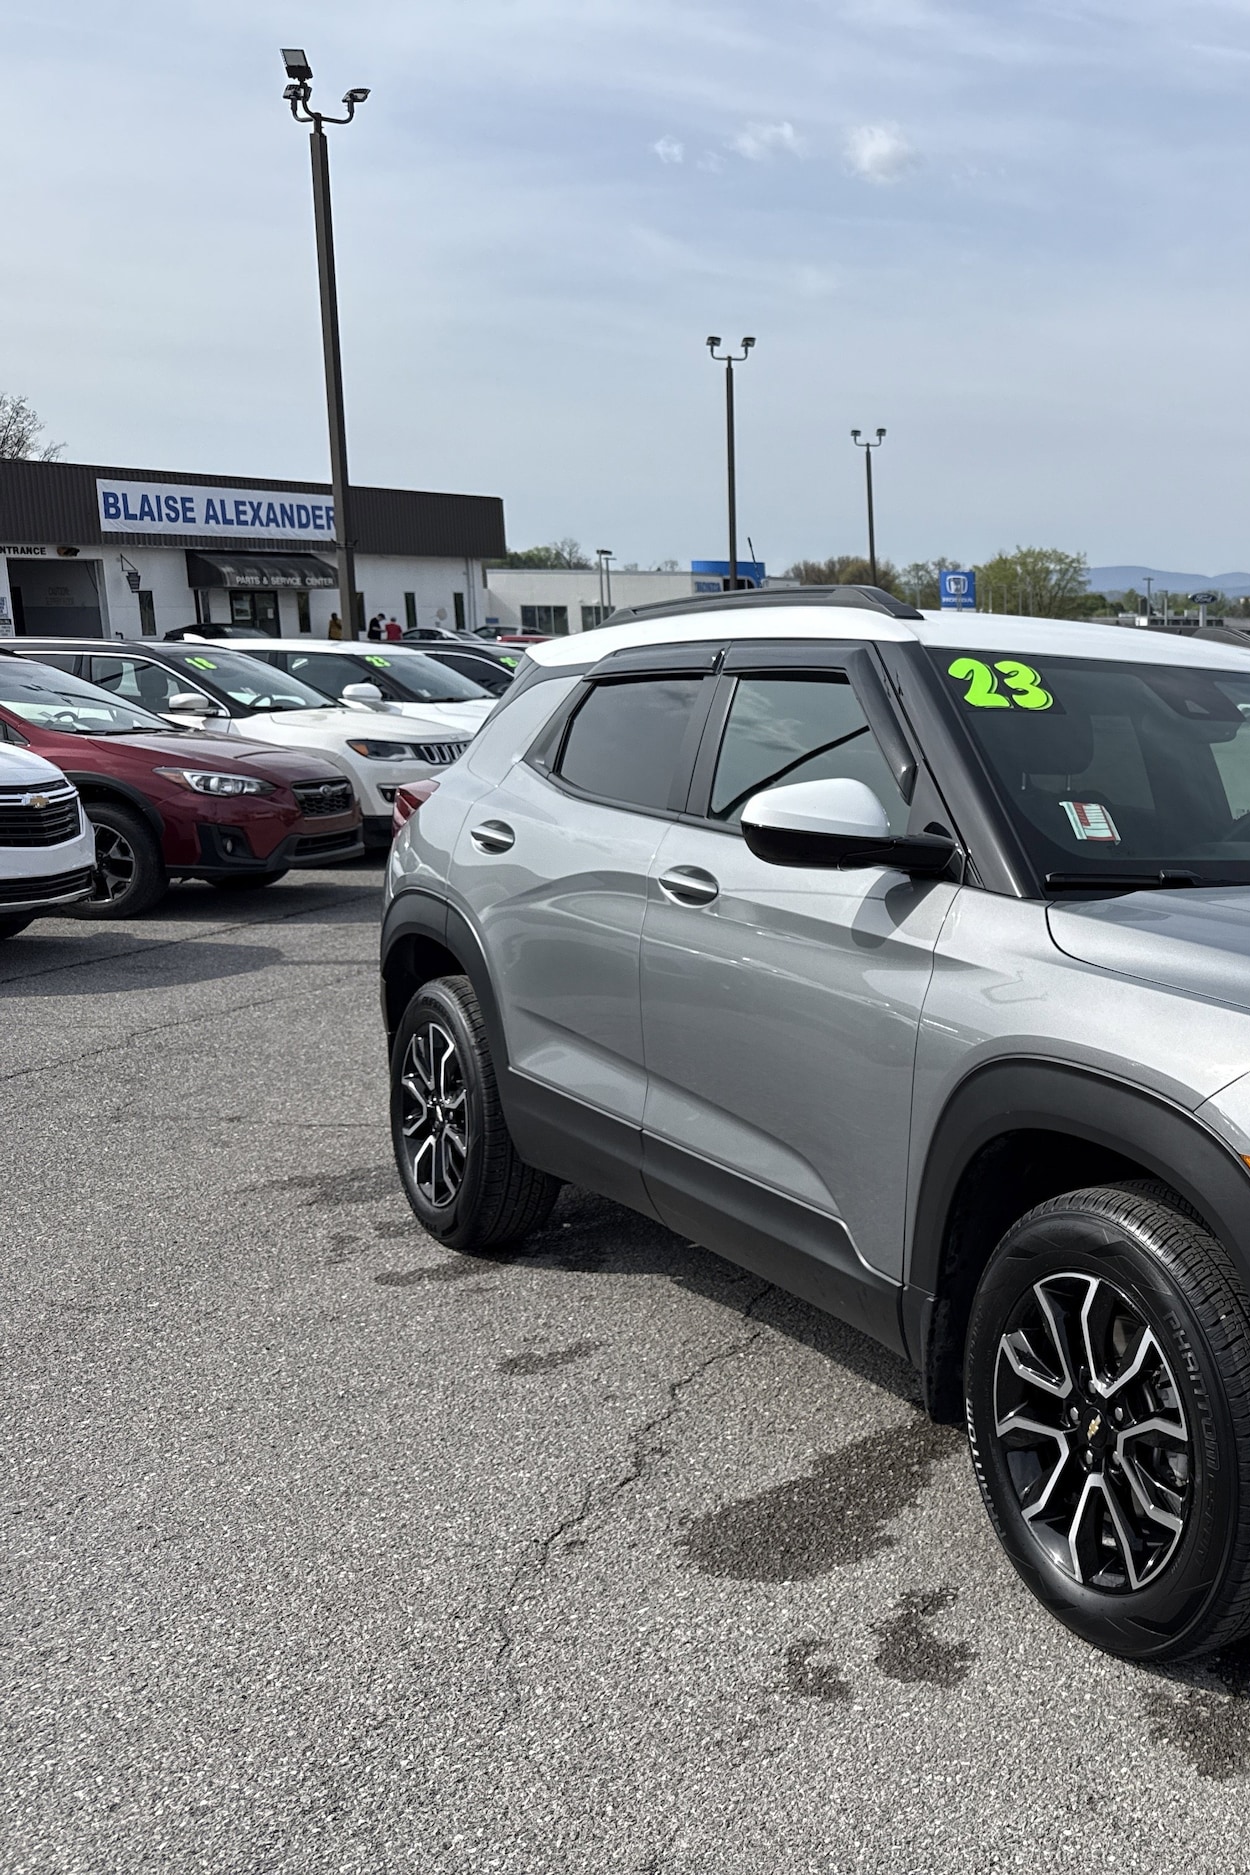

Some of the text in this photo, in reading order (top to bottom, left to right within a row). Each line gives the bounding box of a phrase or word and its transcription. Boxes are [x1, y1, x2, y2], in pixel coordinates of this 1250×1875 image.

[102, 491, 336, 530] BLAISE ALEXANDER
[236, 576, 334, 586] PARTS & SERVICE CENTER
[947, 657, 1054, 711] 23
[1164, 1310, 1221, 1472] PHANTOM
